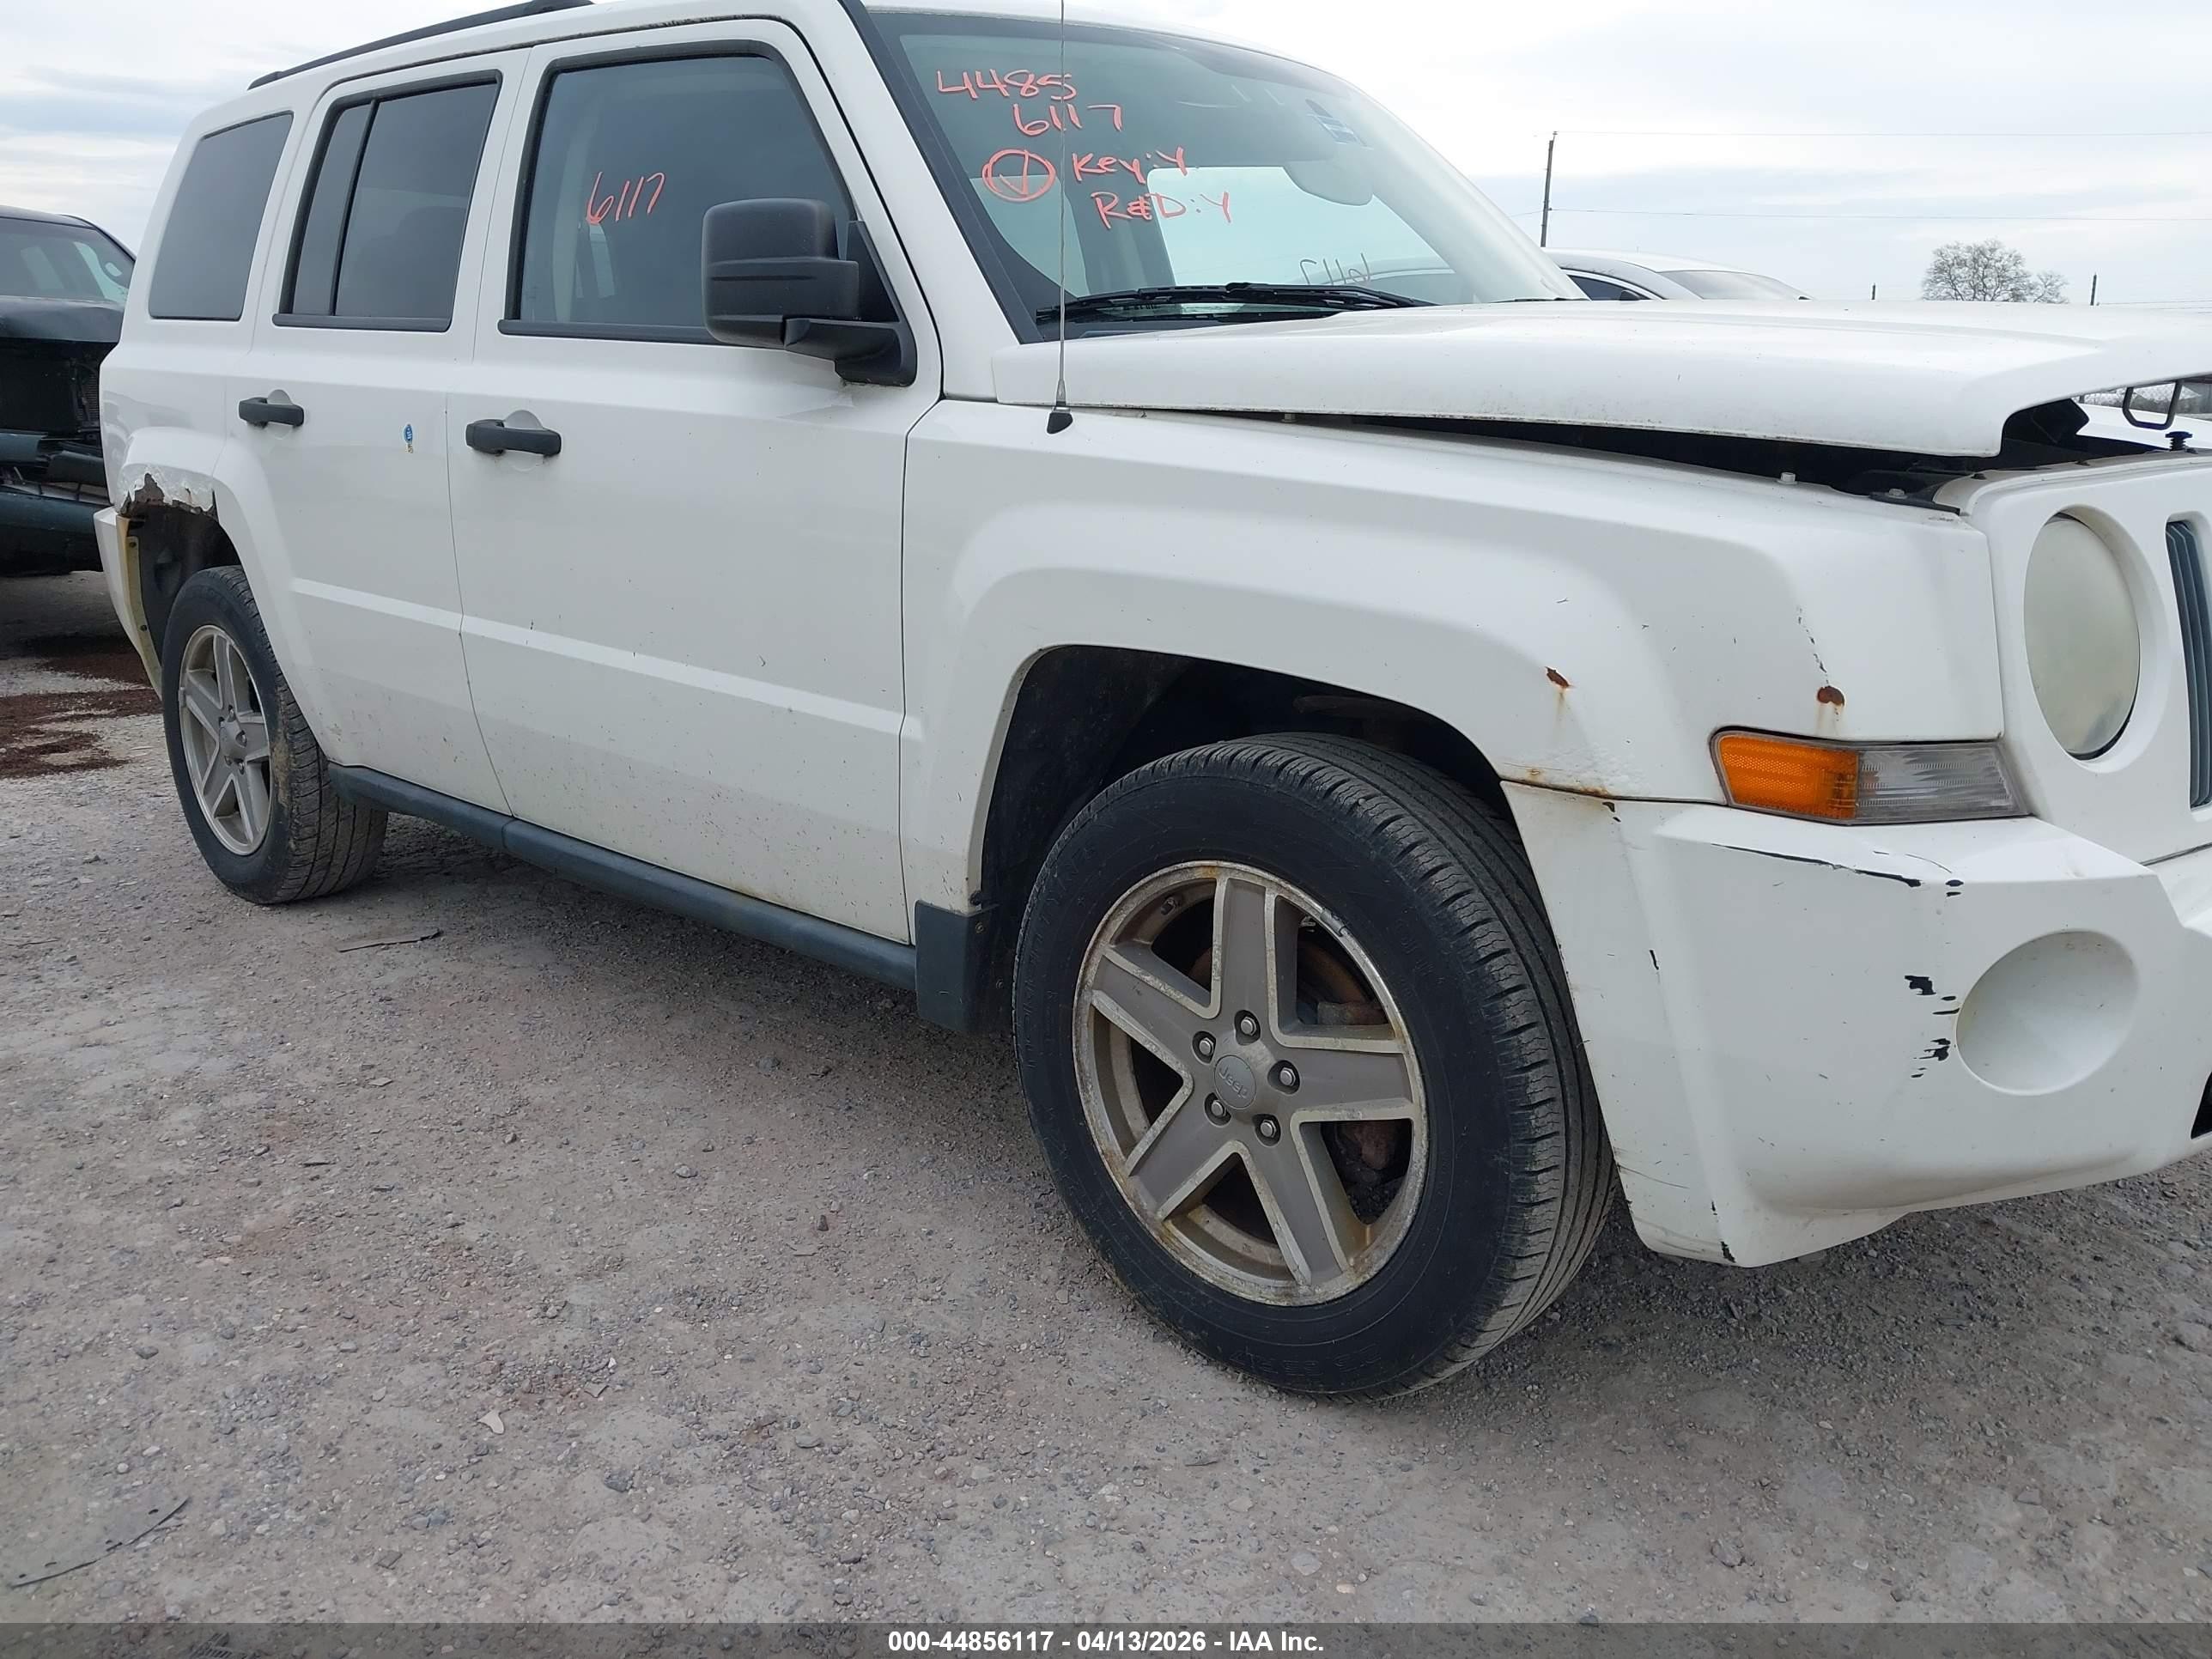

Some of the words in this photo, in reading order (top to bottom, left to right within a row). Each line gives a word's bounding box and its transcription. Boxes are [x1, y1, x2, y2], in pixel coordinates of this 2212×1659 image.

[937, 68, 1078, 100] 4485
[1012, 102, 1123, 137] 6117
[586, 171, 665, 226] 6117
[1218, 1064, 1249, 1099] Jeep
